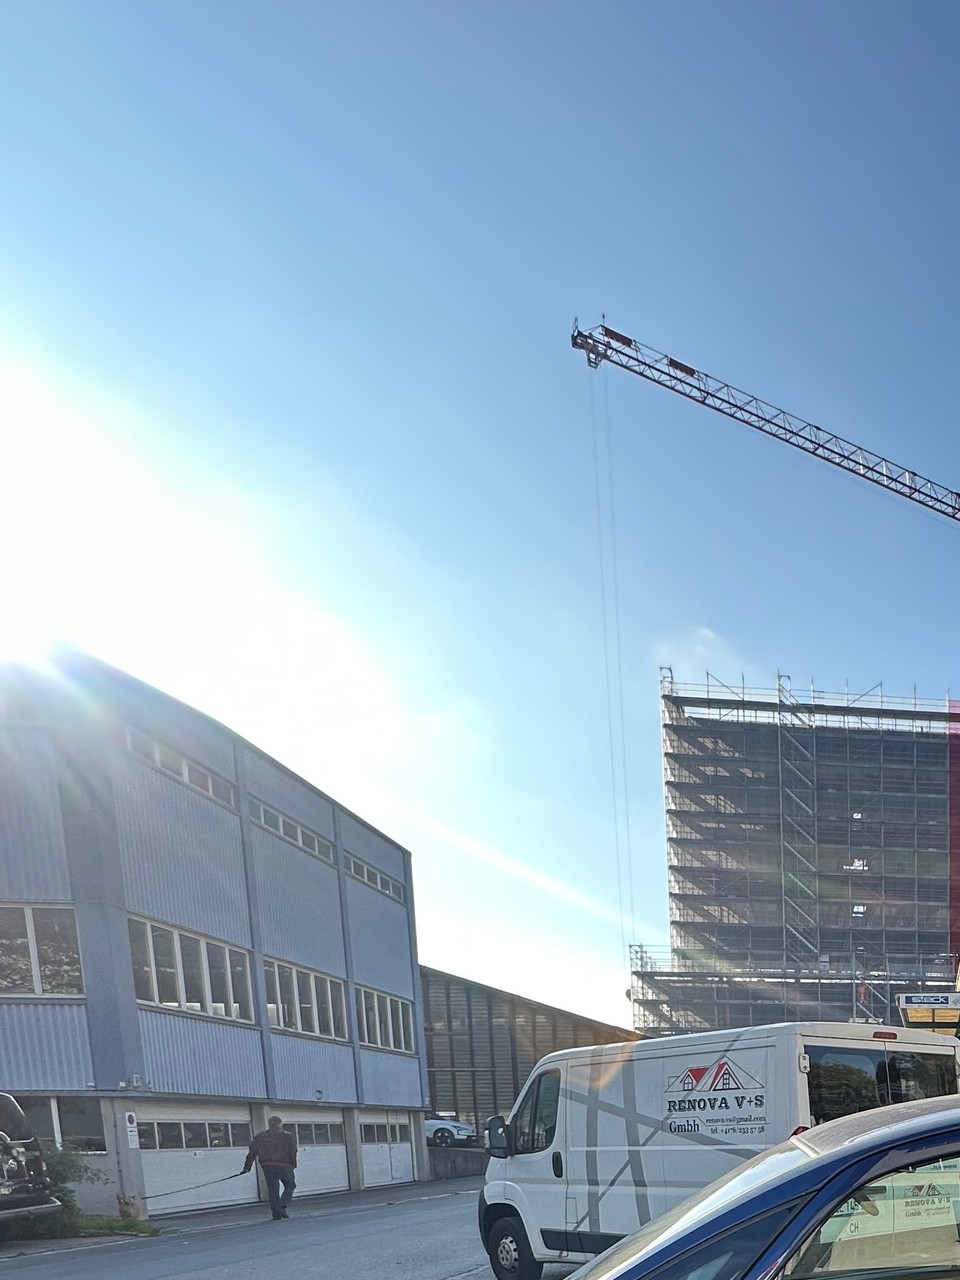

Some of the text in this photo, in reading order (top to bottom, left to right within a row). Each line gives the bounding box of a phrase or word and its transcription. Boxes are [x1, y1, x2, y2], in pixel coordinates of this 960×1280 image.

[911, 995, 947, 1003] steck
[667, 1094, 765, 1113] RENOVA V+S
[669, 1119, 700, 1133] Gmbh
[904, 1199, 936, 1207] RENOVA
[849, 1221, 859, 1234] CH
